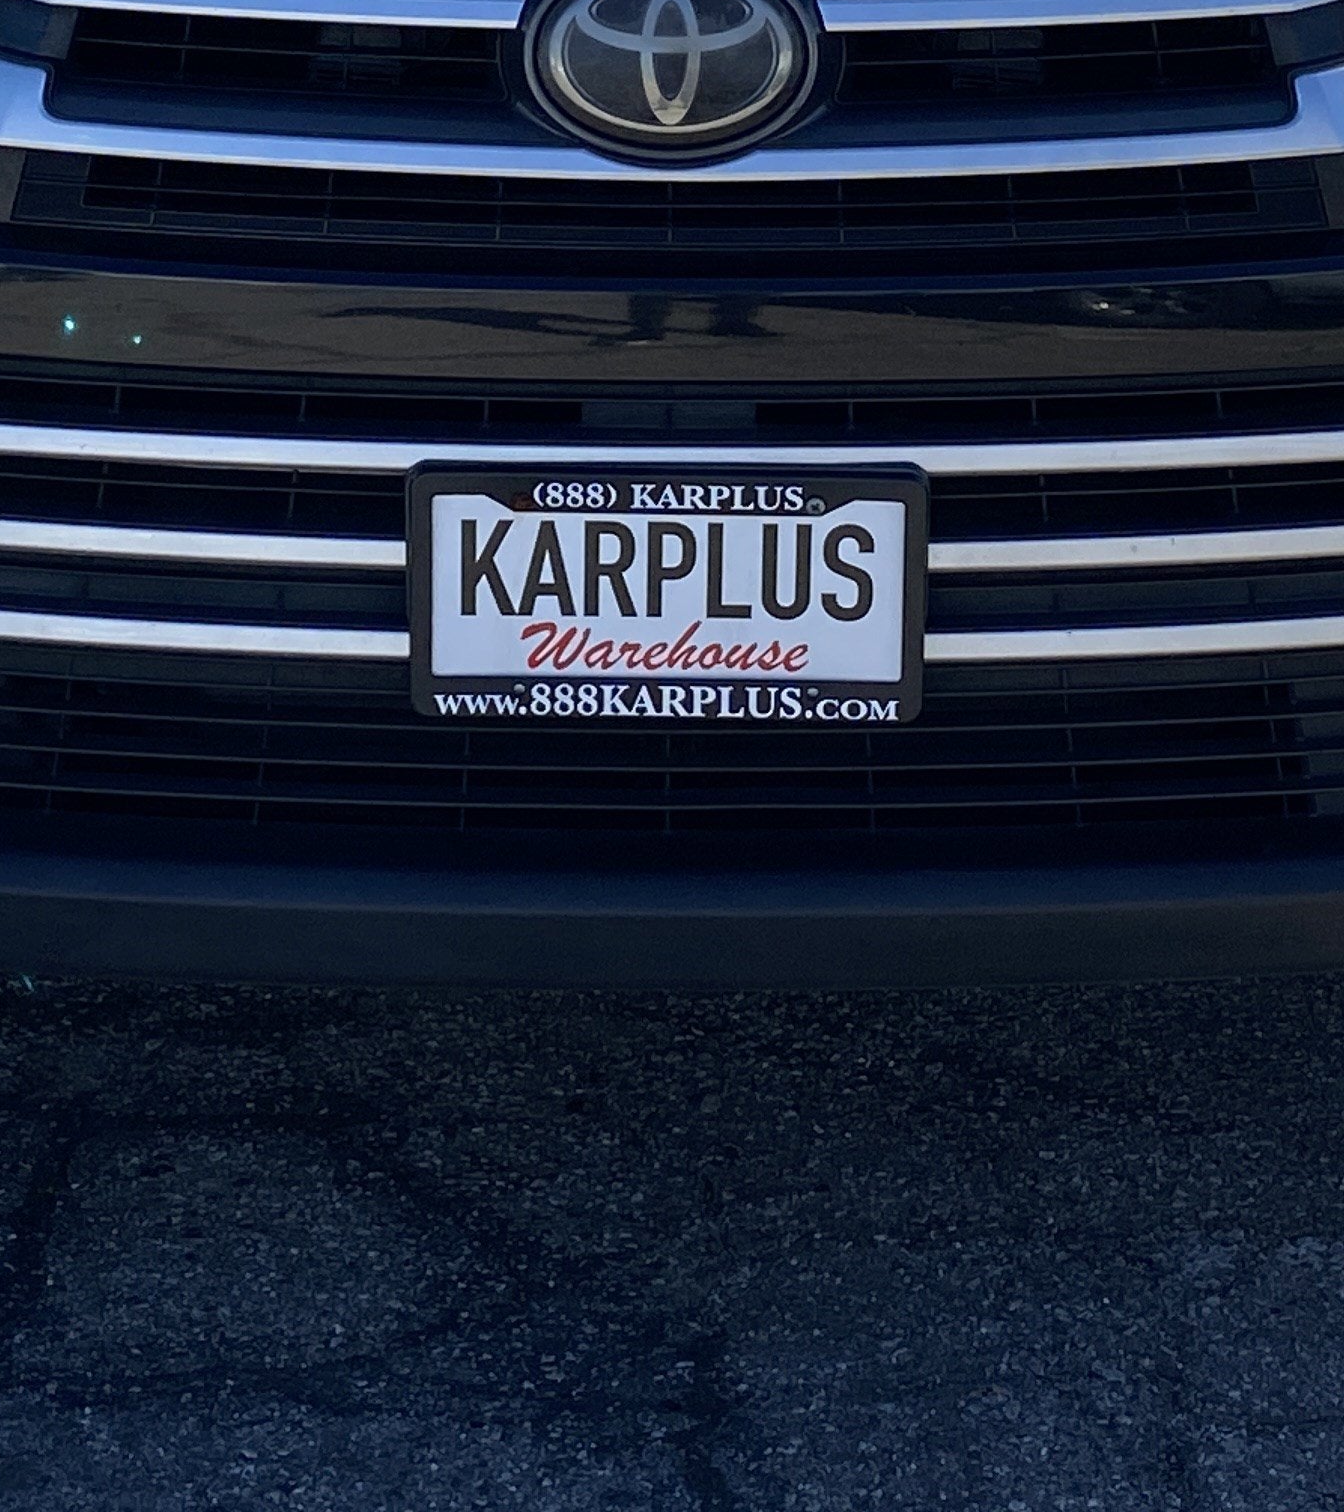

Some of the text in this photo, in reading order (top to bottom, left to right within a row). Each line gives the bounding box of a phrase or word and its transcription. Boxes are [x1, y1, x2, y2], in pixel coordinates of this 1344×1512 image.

[532, 481, 804, 512] (888) KARPLUS
[459, 518, 876, 623] KARPLUS
[519, 620, 810, 673] Warehouse
